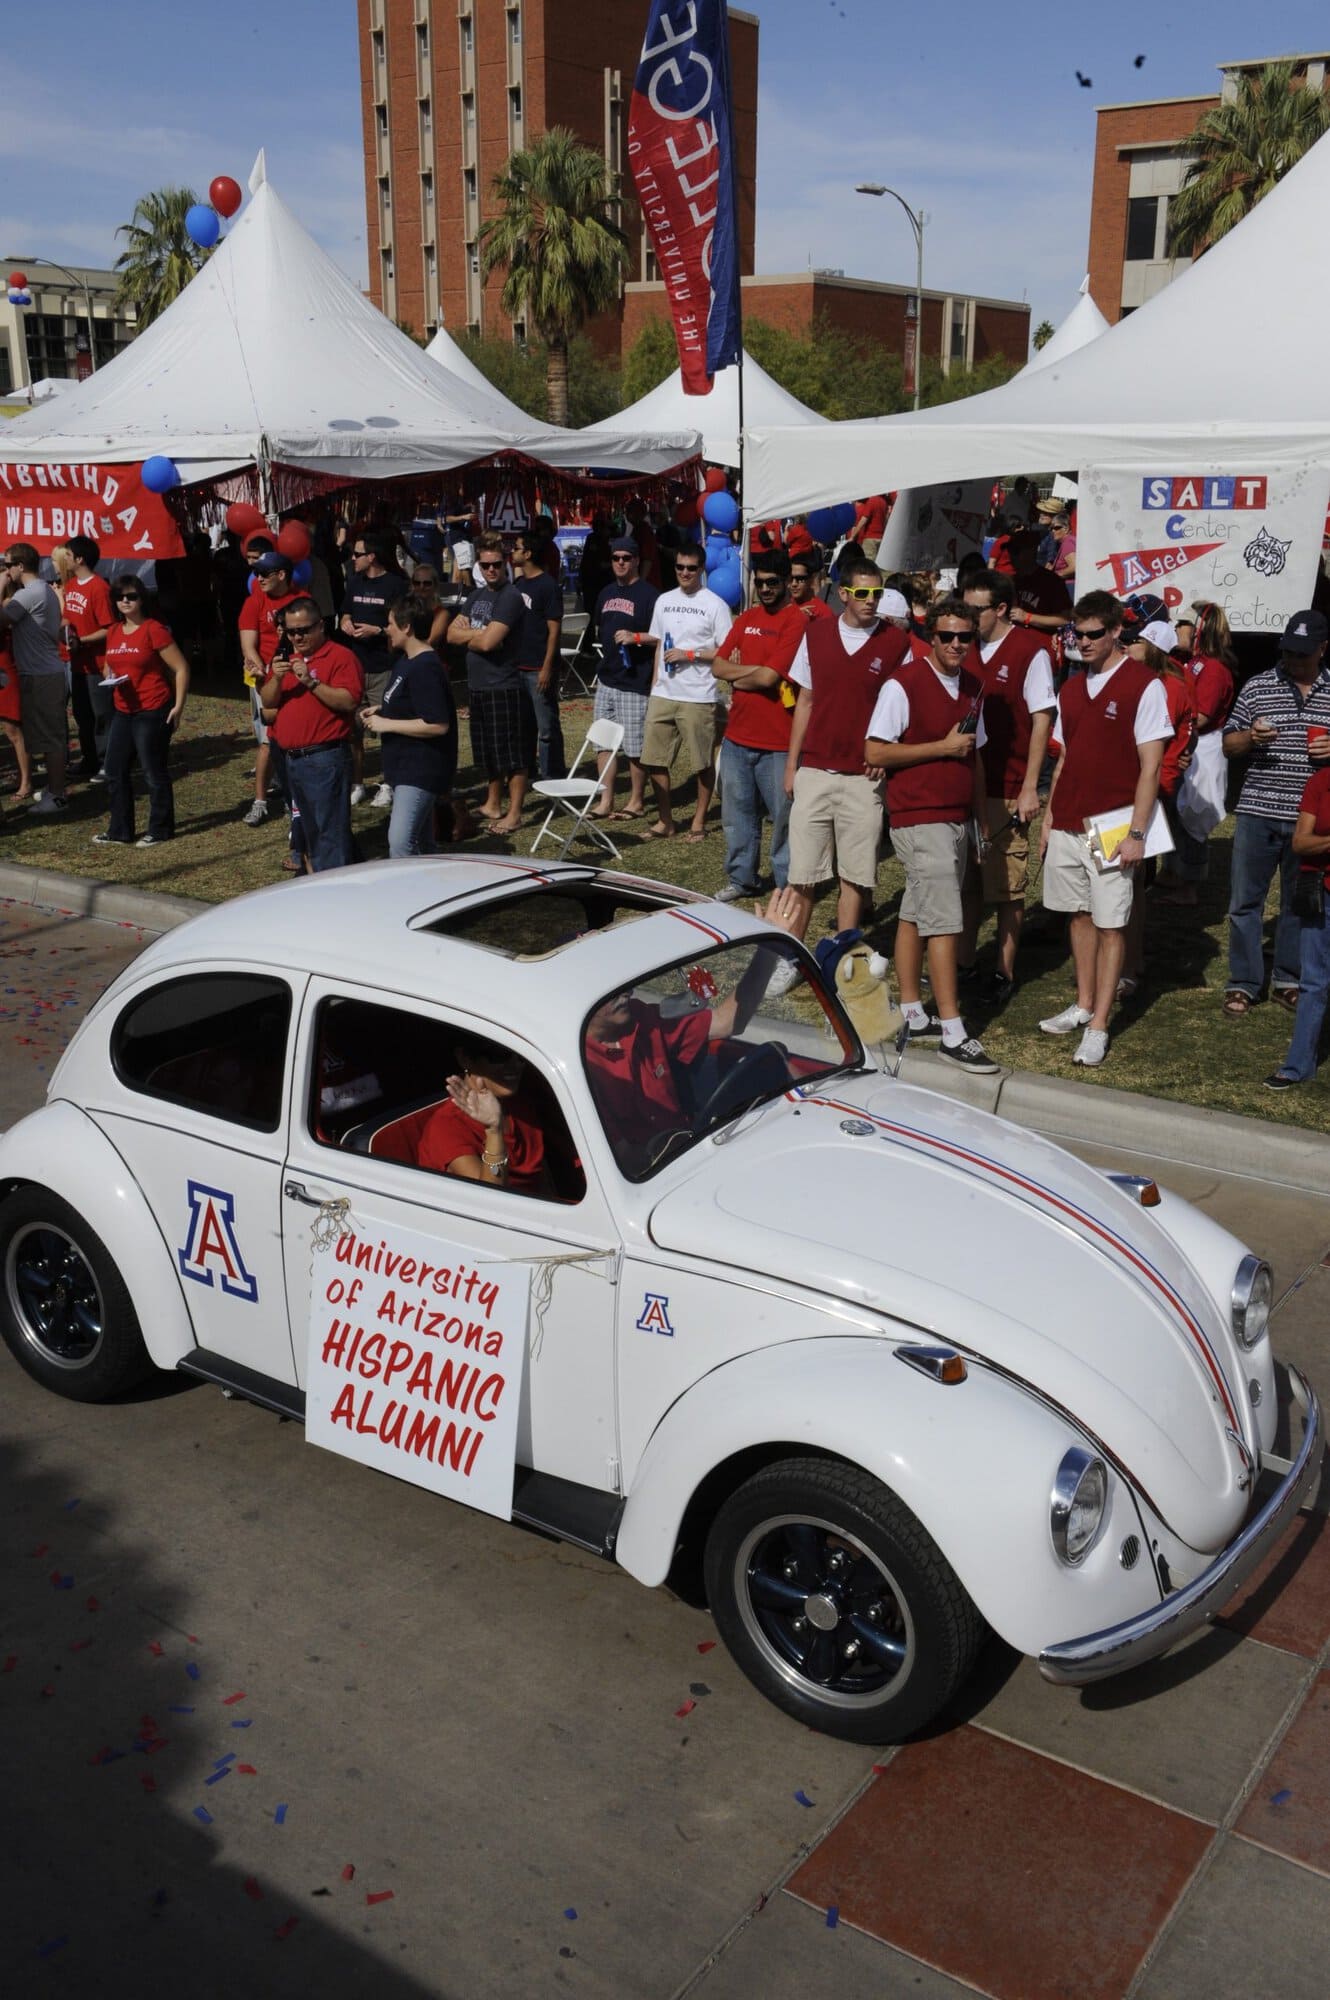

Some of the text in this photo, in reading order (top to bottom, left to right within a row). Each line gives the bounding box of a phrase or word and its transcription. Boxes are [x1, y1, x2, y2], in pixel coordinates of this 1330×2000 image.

[1147, 478, 1261, 508] SALT
[1165, 514, 1240, 540] Center
[1123, 547, 1189, 591] Aged
[1209, 556, 1239, 587] to
[663, 606, 706, 617] BEARDOWN
[177, 1178, 260, 1304] A
[326, 1278, 503, 1358] of Arizona
[636, 1292, 675, 1337] A
[321, 1318, 506, 1423] HISPANIC
[330, 1382, 485, 1478] ALUMNI
